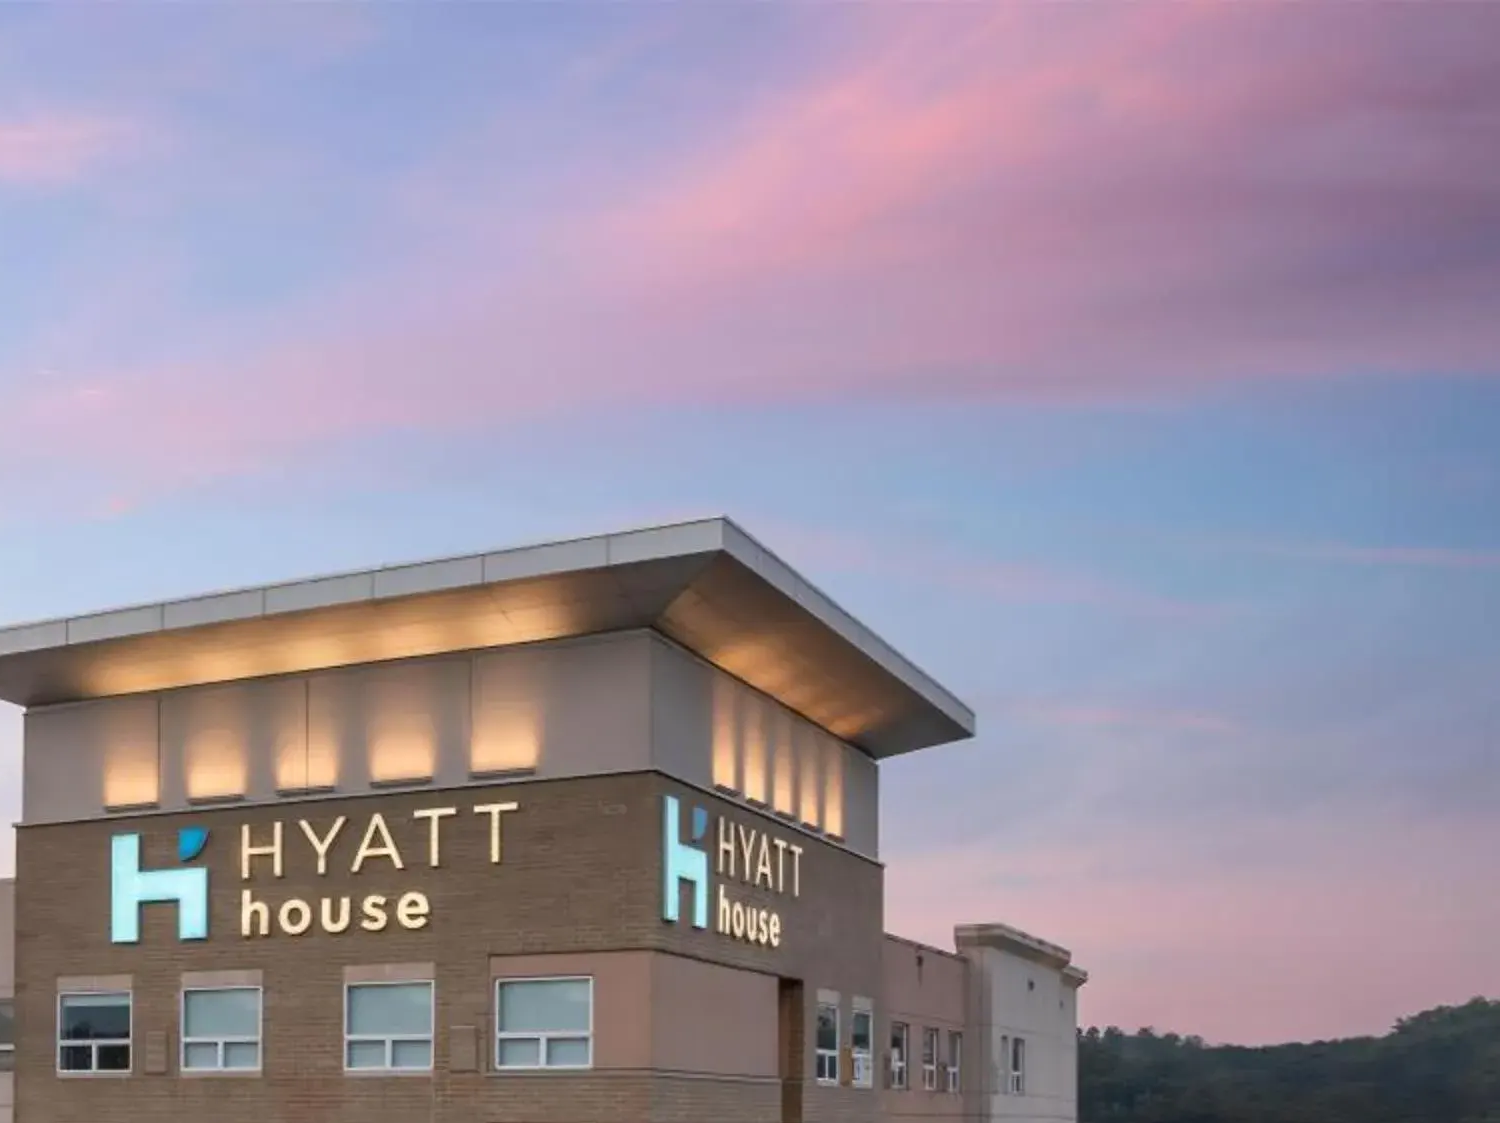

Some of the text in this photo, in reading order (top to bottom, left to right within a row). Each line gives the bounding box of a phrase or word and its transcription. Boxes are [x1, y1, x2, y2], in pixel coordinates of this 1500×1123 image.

[240, 801, 519, 880] HYATT
[718, 815, 803, 897] HYATT
[240, 889, 431, 936] house
[718, 883, 781, 947] house
